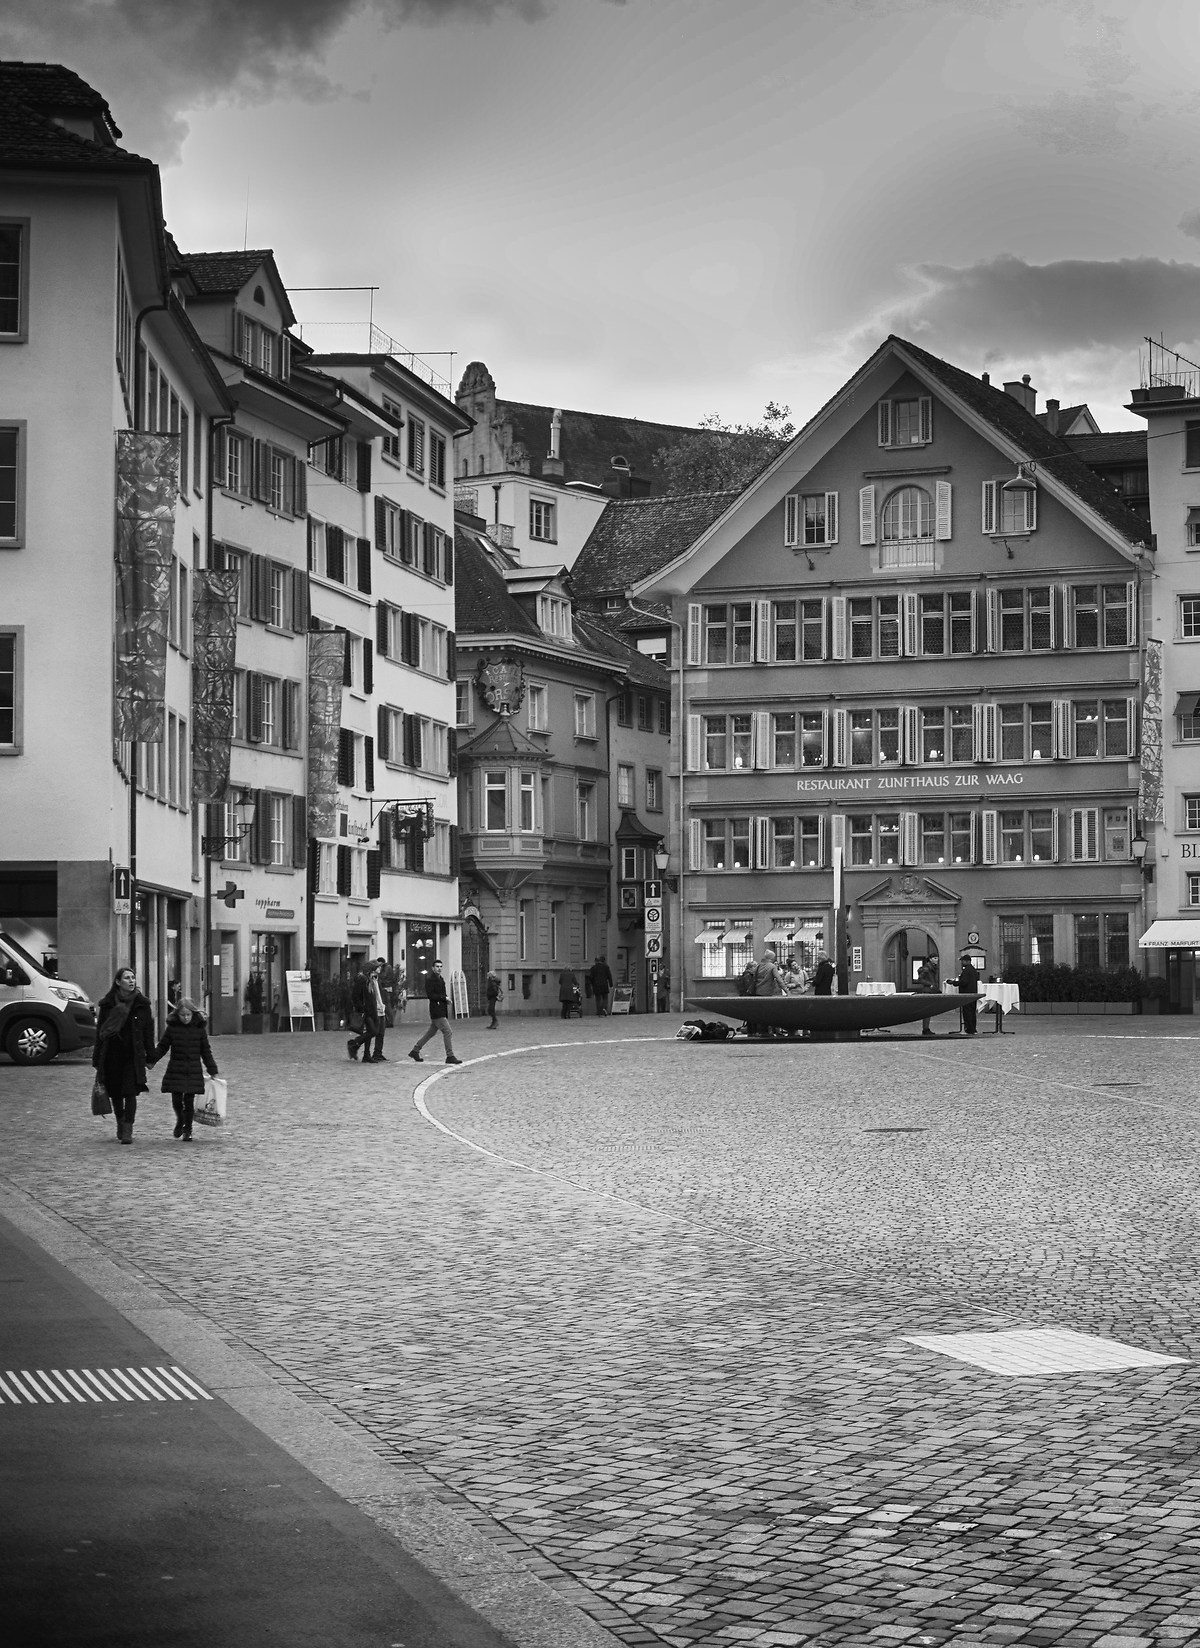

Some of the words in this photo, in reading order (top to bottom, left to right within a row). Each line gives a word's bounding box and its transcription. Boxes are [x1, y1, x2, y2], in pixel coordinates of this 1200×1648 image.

[797, 778, 871, 791] RESTAURANT
[877, 775, 950, 789] ZUNFTHAUS
[955, 774, 980, 786] ZUR
[985, 773, 1024, 785] WAAG
